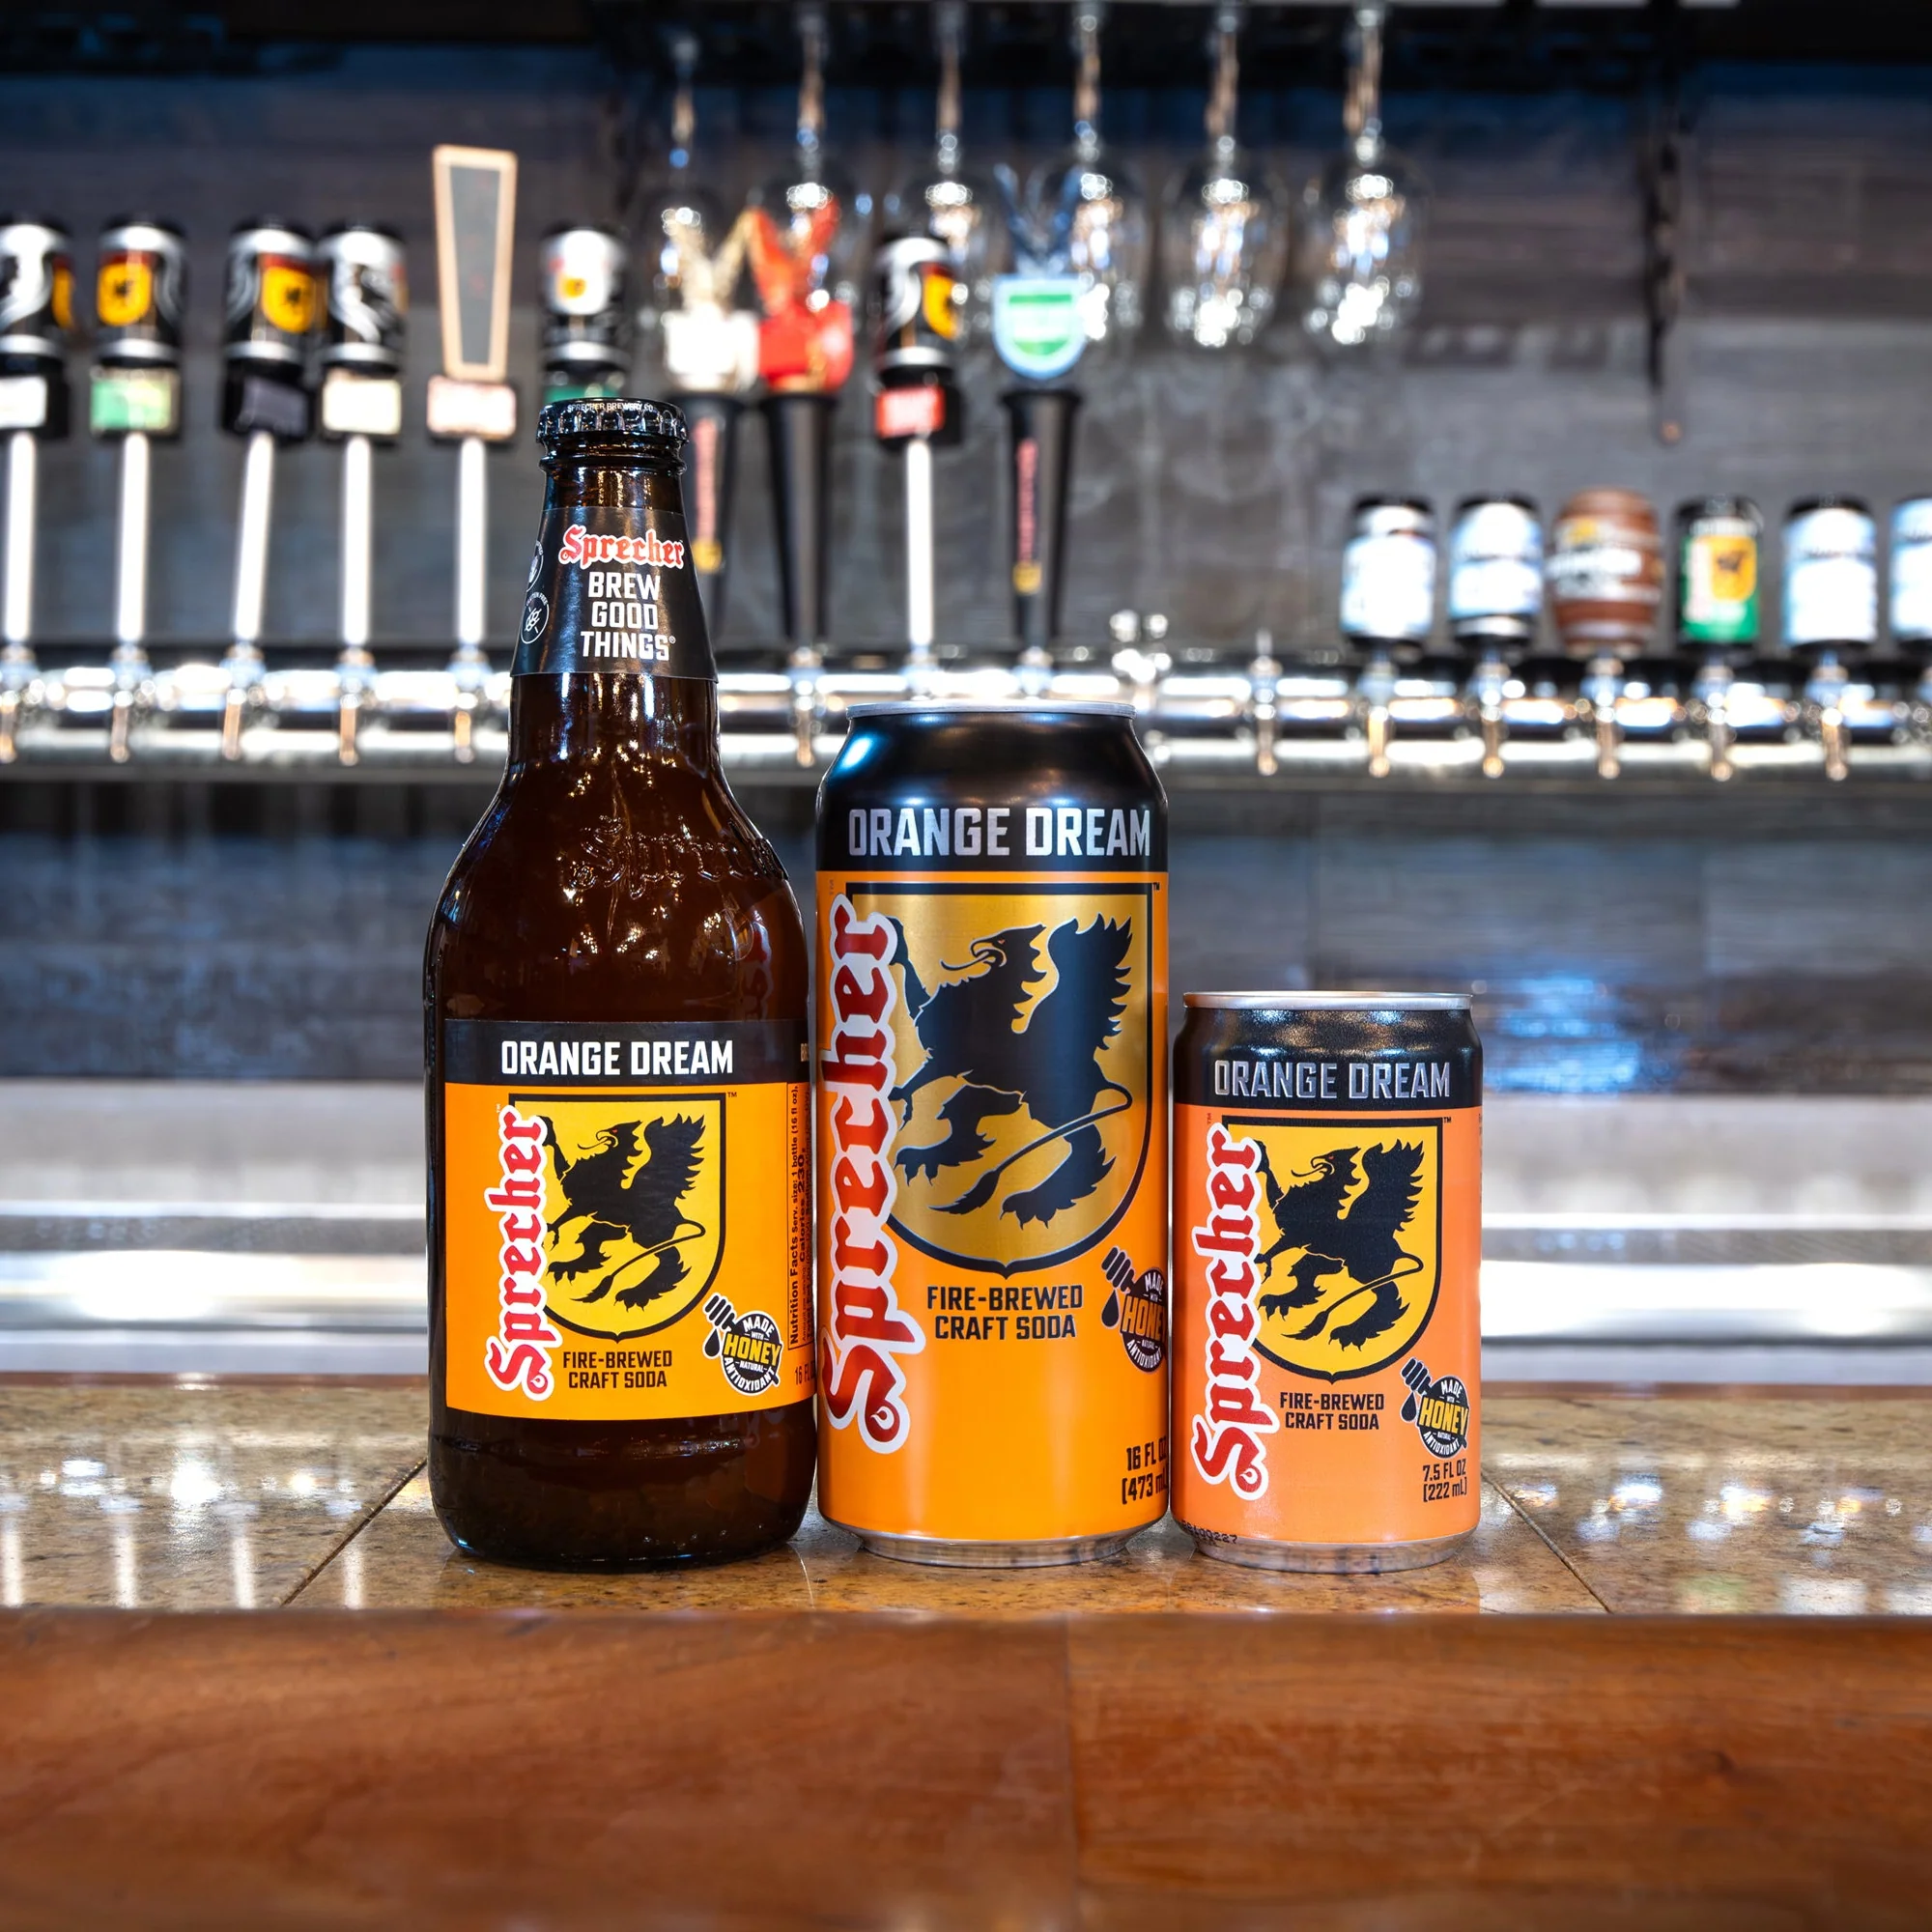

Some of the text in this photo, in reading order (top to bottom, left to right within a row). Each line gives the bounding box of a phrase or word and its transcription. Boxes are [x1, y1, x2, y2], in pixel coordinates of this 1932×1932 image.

[567, 403, 605, 412] SPRECHER
[558, 525, 684, 569] Sprecher
[588, 571, 661, 600] BREW
[591, 601, 659, 630] GOOD
[848, 808, 1151, 857] ORANGE DREAM
[501, 1040, 733, 1076] ORANGE DREAM
[1214, 1060, 1450, 1099] ORANGE DREAM
[821, 895, 924, 1453] Sprecher
[485, 1106, 561, 1400] Sprecher
[789, 1236, 799, 1277] Facts
[926, 1284, 1084, 1311] FIRE-BREWED
[1144, 1271, 1164, 1295] MADE
[789, 1280, 799, 1345] Nutrition
[1192, 1123, 1279, 1499] Sprecher
[742, 1316, 775, 1338] MADE
[751, 1331, 764, 1341] WITH
[935, 1315, 1077, 1341] CRAFT SODA
[562, 1350, 672, 1369] FIRE-BREWED
[723, 1333, 781, 1367] HONEY
[568, 1370, 668, 1389] CRAFT SODA
[724, 1356, 775, 1391] ANTIOXIDANT
[739, 1360, 764, 1374] NATURAL
[1279, 1392, 1385, 1411] FIRE-BREWED
[1440, 1379, 1463, 1399] MADE
[1285, 1412, 1379, 1431] CRAFT SODA
[1418, 1397, 1469, 1436] HONEY
[1126, 1445, 1141, 1471] 16
[1144, 1440, 1156, 1467] FL
[1423, 1431, 1461, 1456] ANTIOXIDANT
[1422, 1458, 1466, 1482] 7.5 FL OZ
